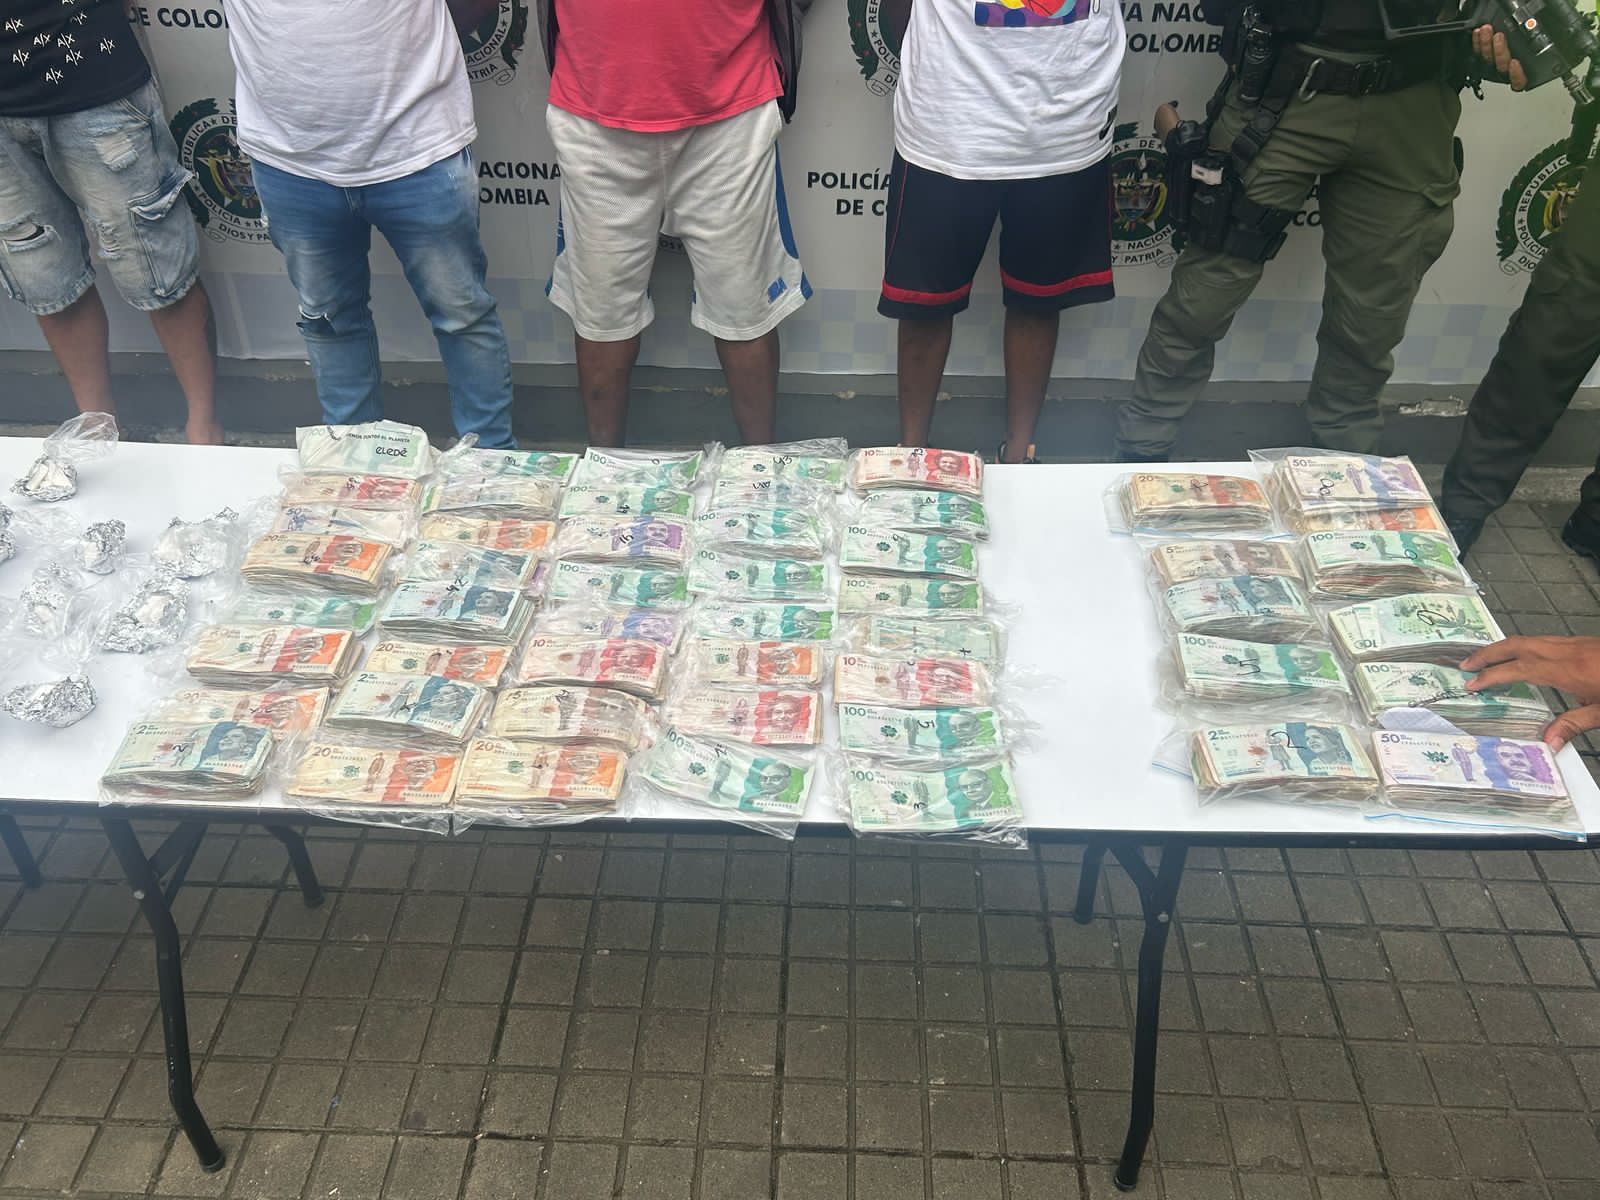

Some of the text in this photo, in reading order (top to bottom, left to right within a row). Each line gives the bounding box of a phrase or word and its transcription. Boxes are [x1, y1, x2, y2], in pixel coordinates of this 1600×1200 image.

[157, 8, 229, 29] COLO
[467, 28, 506, 64] ACIONAL
[1127, 33, 1223, 53] OLOMB
[884, 74, 898, 87] DI
[183, 121, 212, 171] EPUBLICA
[478, 161, 561, 179] ACIONA
[1518, 156, 1567, 213] REPUBLIC
[480, 187, 550, 205] OMBIA
[836, 199, 863, 215] DE
[1127, 228, 1172, 251] NACION
[1518, 225, 1547, 256] POLICIA
[1124, 248, 1163, 264] PATRIA
[1518, 255, 1537, 270] DIO
[589, 451, 607, 465] 100
[864, 449, 875, 457] 10
[1293, 458, 1308, 467] 50
[847, 526, 868, 535] 100
[1311, 533, 1334, 541] 100
[1166, 546, 1174, 554] 5
[559, 562, 580, 573] 100
[401, 584, 410, 592] 2
[846, 580, 866, 588] 100
[1167, 588, 1175, 598] 2
[377, 642, 394, 652] 20
[532, 638, 546, 648] 10
[1183, 635, 1206, 647] 100
[843, 656, 857, 666] 10
[1235, 658, 1261, 676] 5
[1364, 664, 1390, 674] 100
[357, 673, 369, 683] 2
[844, 706, 867, 717] 100
[135, 724, 147, 736] 2
[1207, 729, 1220, 741] 2
[666, 727, 685, 748] 100
[1380, 733, 1401, 744] 50
[312, 746, 332, 758] 20
[475, 740, 495, 752] 20
[850, 770, 875, 783] 100
